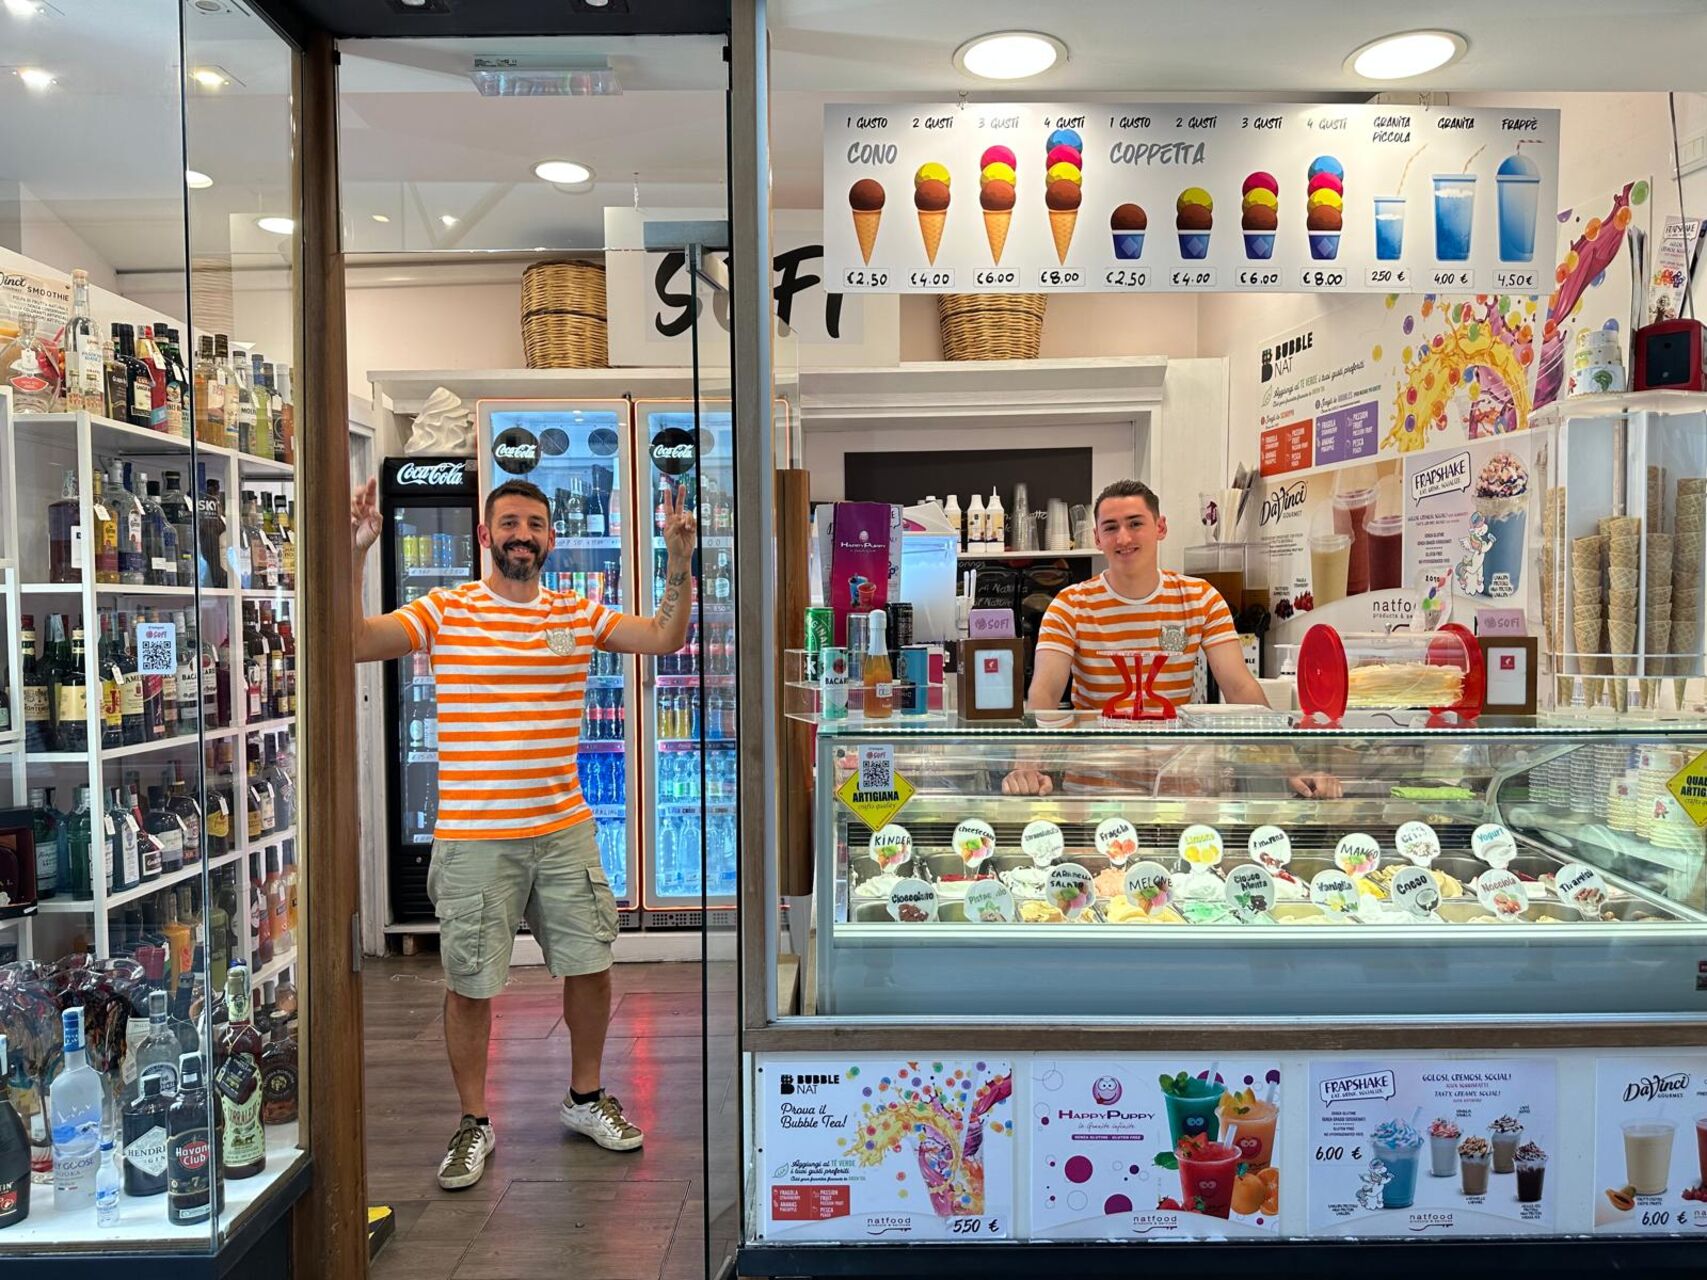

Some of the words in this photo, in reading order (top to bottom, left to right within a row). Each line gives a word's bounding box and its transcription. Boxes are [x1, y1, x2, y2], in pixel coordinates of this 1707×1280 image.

[847, 117, 851, 128] 1
[856, 117, 888, 128] GUSTO
[912, 117, 920, 128] 2
[978, 117, 985, 128] 3
[1044, 117, 1050, 128] 4
[1110, 117, 1114, 128] 1
[1120, 117, 1150, 128] GUSTO
[1176, 117, 1182, 128] 2
[1242, 117, 1248, 128] 3
[1307, 118, 1313, 128] 4
[847, 141, 898, 166] CONO
[1110, 141, 1206, 166] COPPETTA
[1397, 272, 1406, 282] €
[1460, 274, 1468, 284] €
[27, 286, 70, 302] SMOOTHIE
[1275, 332, 1313, 360] BUBBLE
[1274, 356, 1293, 378] NAT
[1415, 460, 1466, 490] FRAPSHAKE
[1260, 480, 1308, 527] DaVinci
[1373, 598, 1416, 612] natfo
[988, 618, 1010, 630] SOFI
[852, 791, 900, 802] ARTIGIANA
[1340, 842, 1378, 858] MANGO
[1129, 875, 1172, 891] MELONE
[797, 1074, 840, 1084] BUBBLE
[1324, 1075, 1388, 1093] FRAPSHAKE
[797, 1085, 818, 1094] NAT
[1624, 1073, 1690, 1102] DaVinci
[781, 1102, 815, 1114] Prova
[819, 1104, 827, 1114] il
[781, 1115, 818, 1129] Bubble
[822, 1114, 848, 1128] Tea!
[176, 1144, 209, 1157] Havan
[1351, 1146, 1362, 1160] €
[184, 1154, 206, 1166] Club
[824, 1168, 849, 1176] preferiti
[1677, 1211, 1687, 1224] €
[988, 1219, 999, 1232] €
